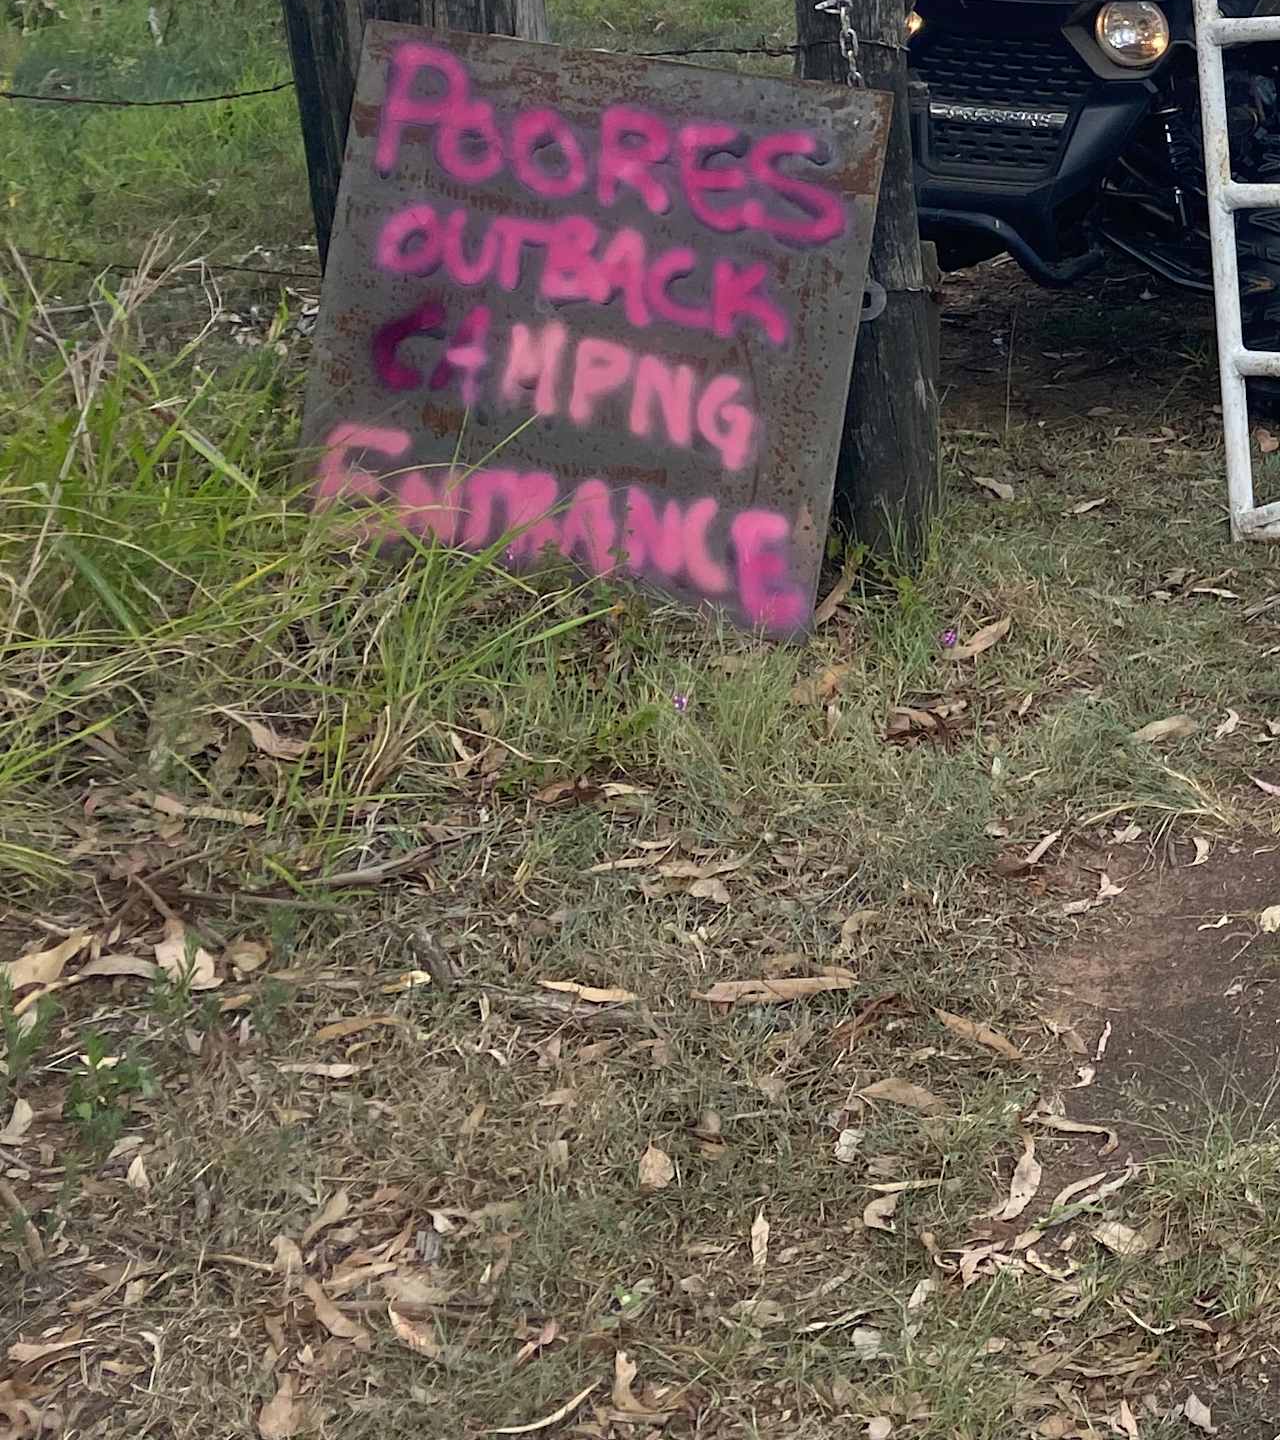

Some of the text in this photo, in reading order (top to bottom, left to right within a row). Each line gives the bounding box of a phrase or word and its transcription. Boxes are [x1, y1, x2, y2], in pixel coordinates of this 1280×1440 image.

[375, 43, 847, 242] POORES
[376, 203, 790, 346] OUTBACK
[371, 303, 757, 471] CAMPNG
[313, 422, 808, 633] ENTRANCE
